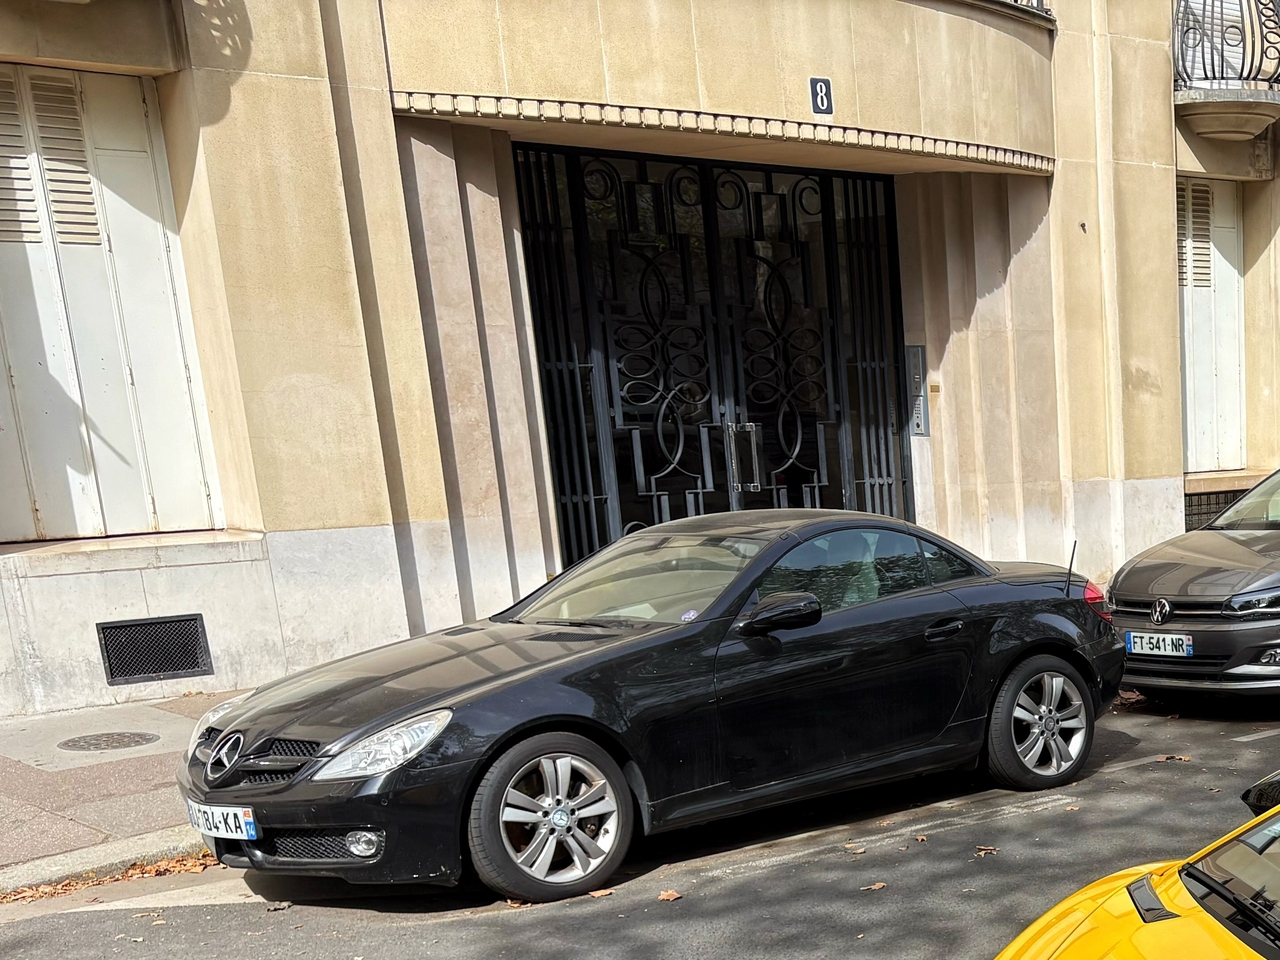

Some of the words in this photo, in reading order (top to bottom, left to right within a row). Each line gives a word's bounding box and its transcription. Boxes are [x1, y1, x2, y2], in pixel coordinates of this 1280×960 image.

[816, 82, 828, 110] 8
[1132, 636, 1185, 653] FT-541-NR
[246, 824, 255, 836] 14
